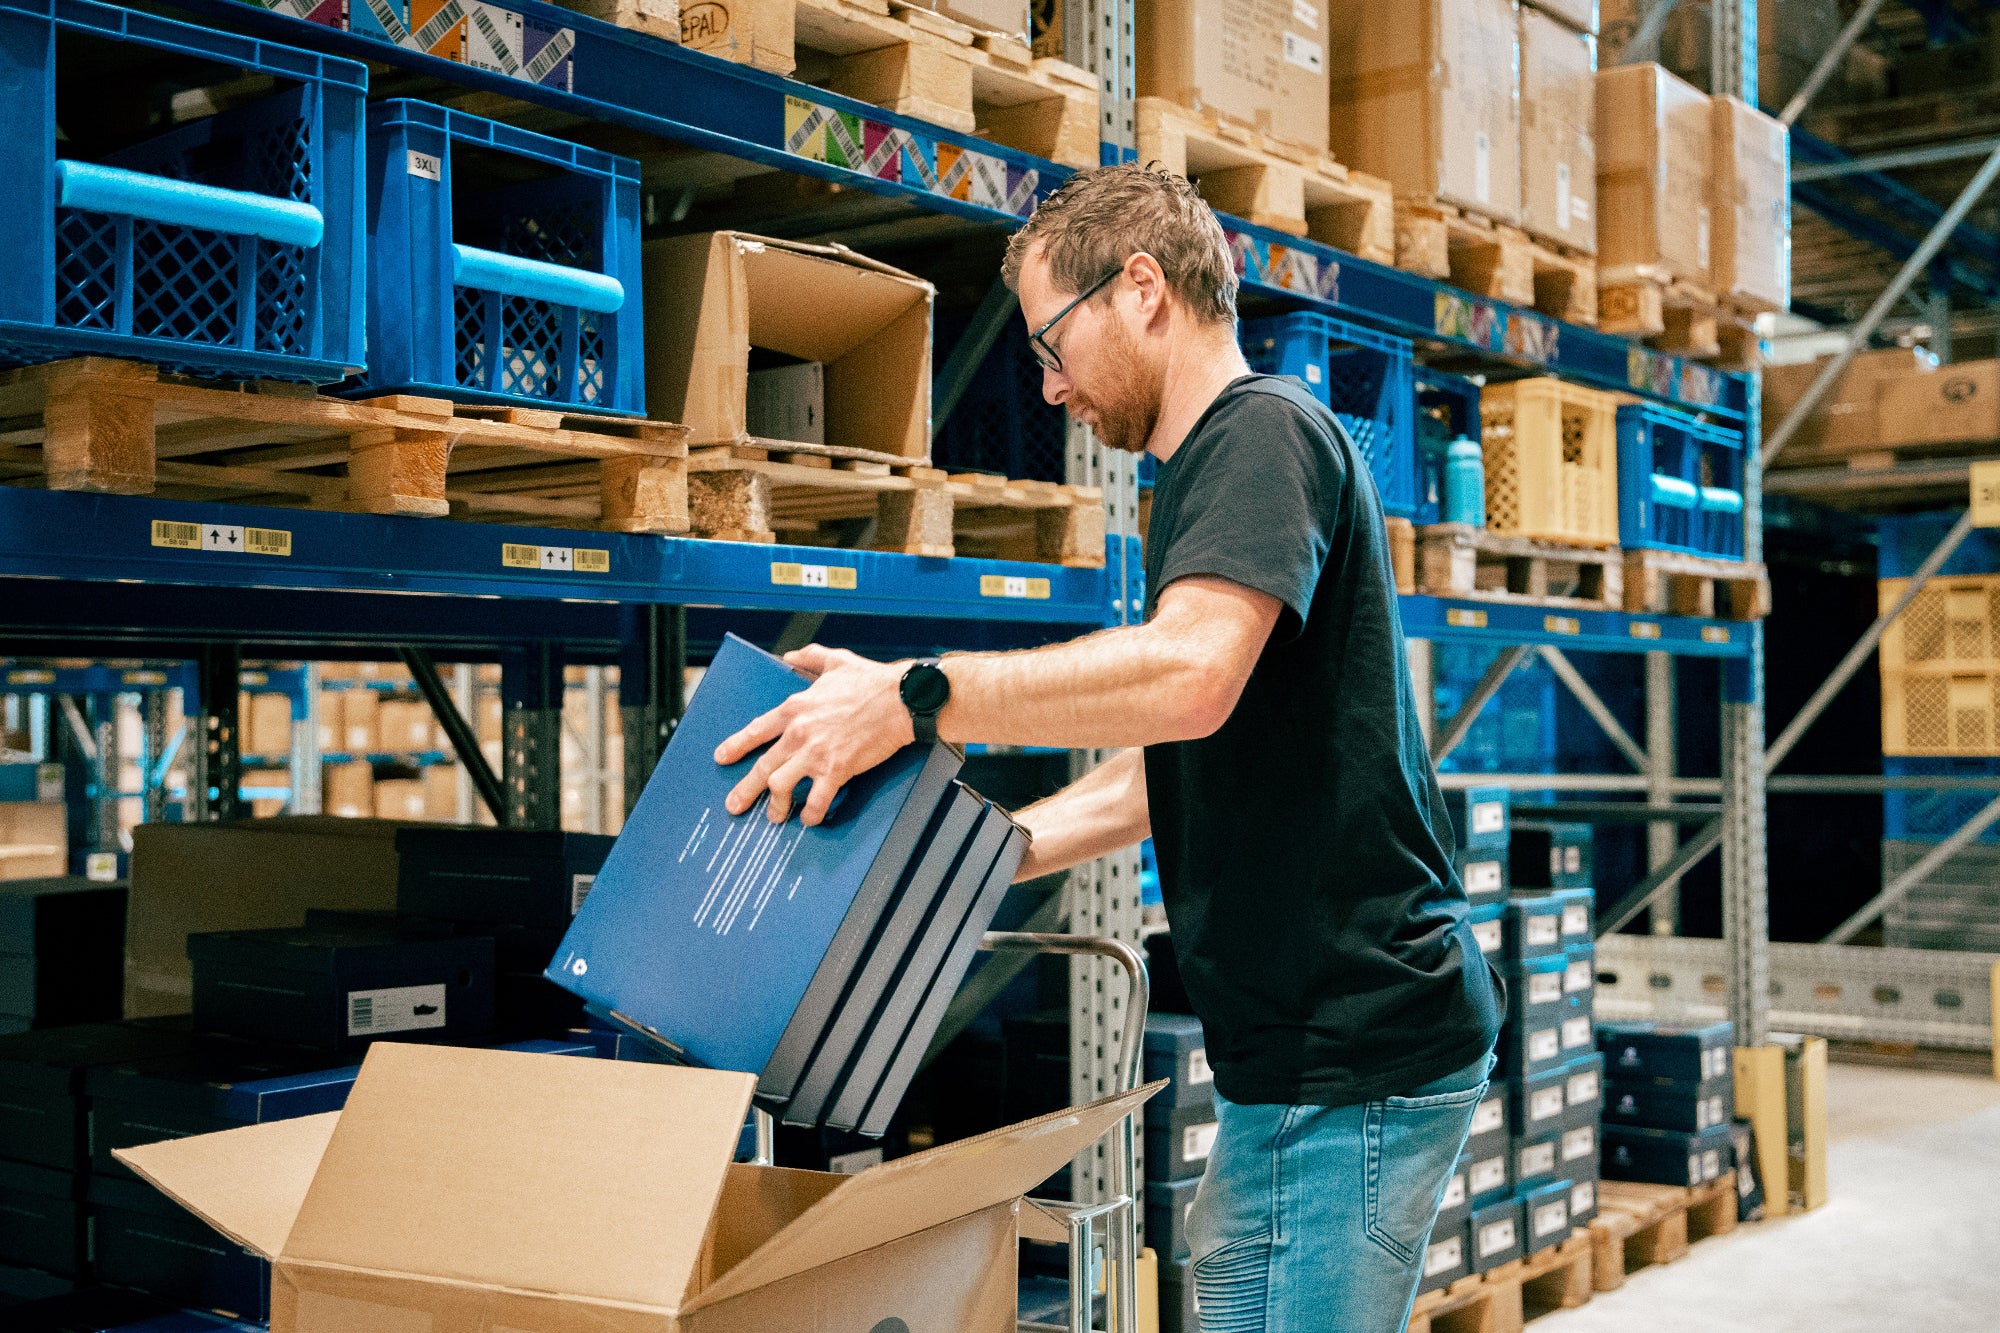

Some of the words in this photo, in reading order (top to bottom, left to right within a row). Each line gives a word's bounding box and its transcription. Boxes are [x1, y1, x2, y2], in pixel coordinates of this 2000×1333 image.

[505, 13, 512, 23] F
[681, 11, 719, 43] EPAL
[415, 157, 436, 173] 3XL
